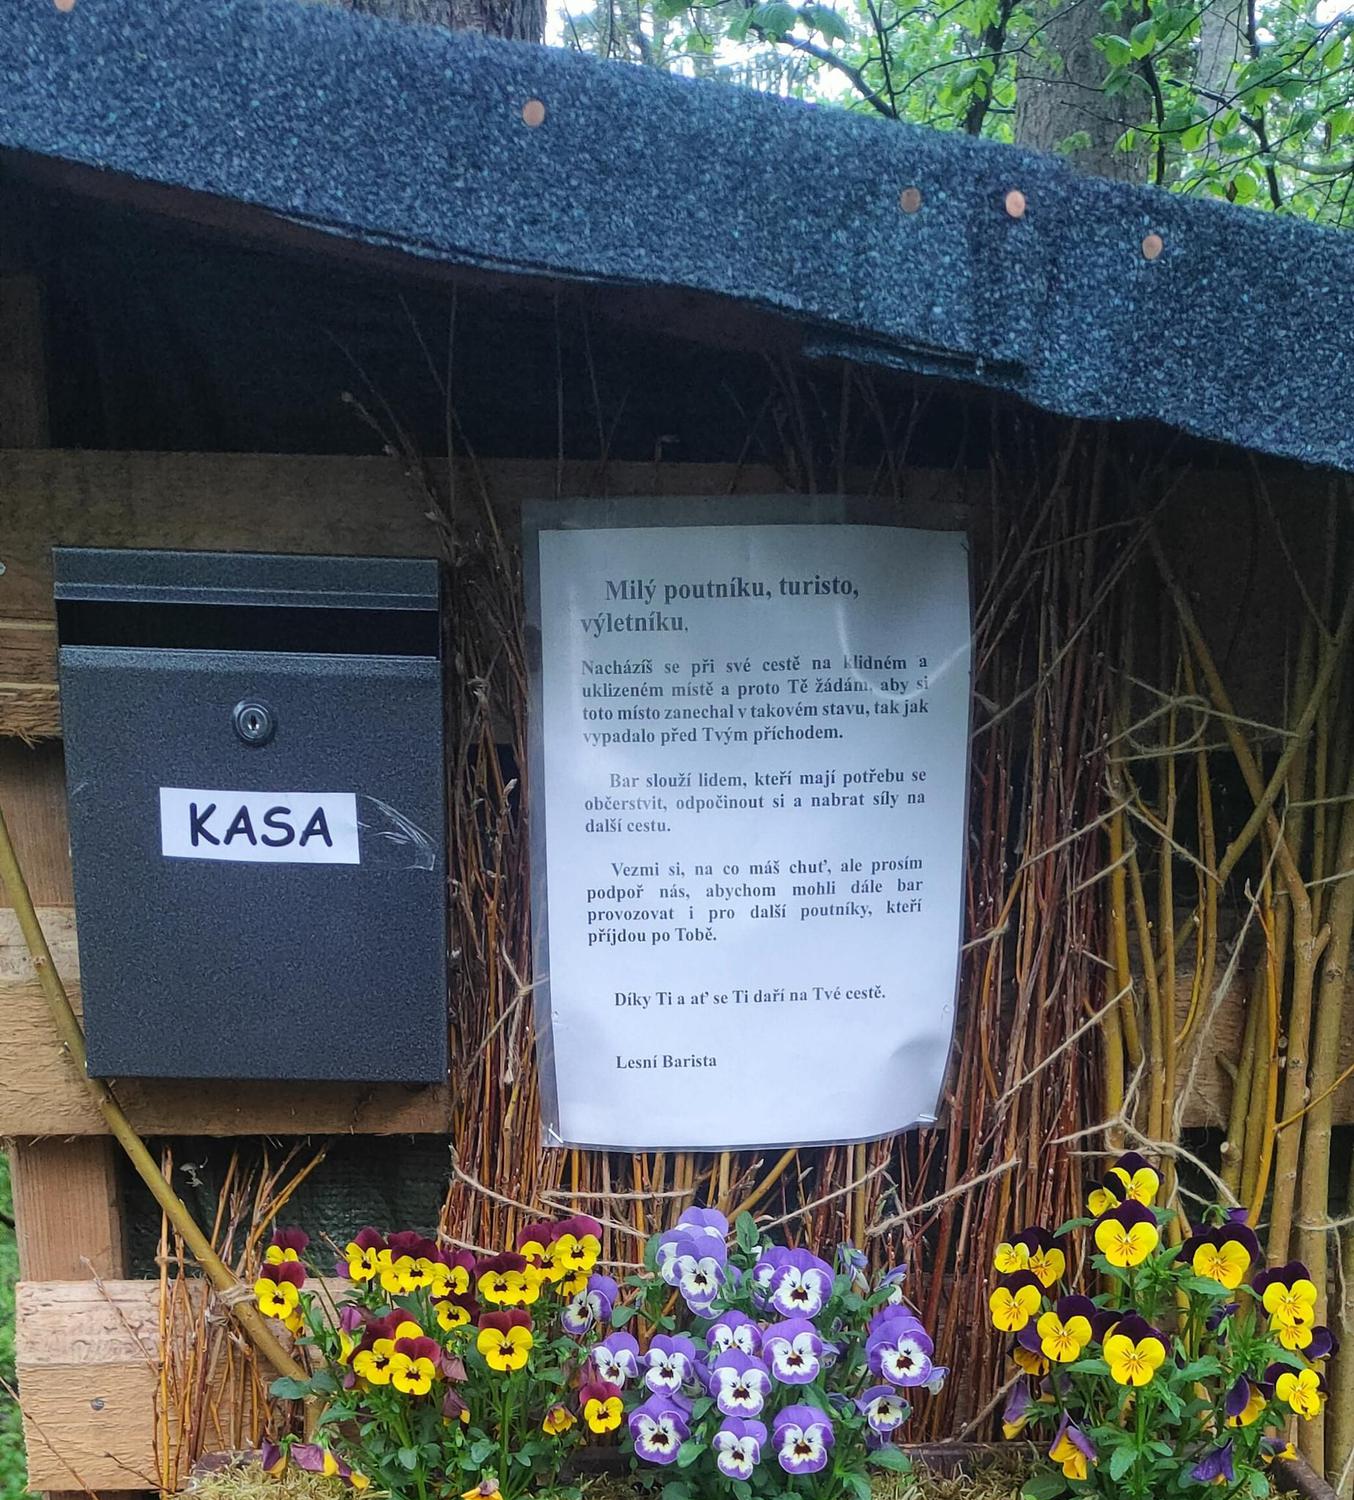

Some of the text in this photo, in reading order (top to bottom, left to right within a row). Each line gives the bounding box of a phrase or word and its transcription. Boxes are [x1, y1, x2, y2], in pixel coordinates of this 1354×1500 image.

[606, 575, 858, 605] Milý poutníku, turisto,
[582, 655, 927, 677] Nacházíš se při své cestě na klidném a
[583, 682, 663, 697] uklizeném
[672, 682, 713, 696] místě
[721, 686, 729, 695] a
[738, 683, 779, 699] proto
[788, 679, 808, 693] Tě
[881, 678, 908, 694] aby
[917, 676, 928, 689] si
[583, 699, 928, 720] toto místo zanechal v takovém stavu, tak jak
[584, 725, 843, 747] vypadalo před Tvým příchodem.
[610, 768, 926, 789] Bar slouží lidem, kteří mají potřebu se
[585, 791, 925, 813] občerstvit, odpočinout si a nabrat síly na
[190, 802, 333, 847] KASA
[586, 818, 670, 832] další cestu.
[611, 856, 922, 878] Vezmi si, na co máš chuť, ale prosím
[587, 878, 923, 903] podpoř nás, abychom mohli dále bar
[588, 899, 922, 925] provozovat i pro další poutníky, kteří
[589, 927, 716, 946] příjdou po Tobě.
[615, 985, 885, 1009] Díky Ti a ať se Ti daří na Tvé cestě.
[617, 1055, 716, 1069] Lesní Barista
